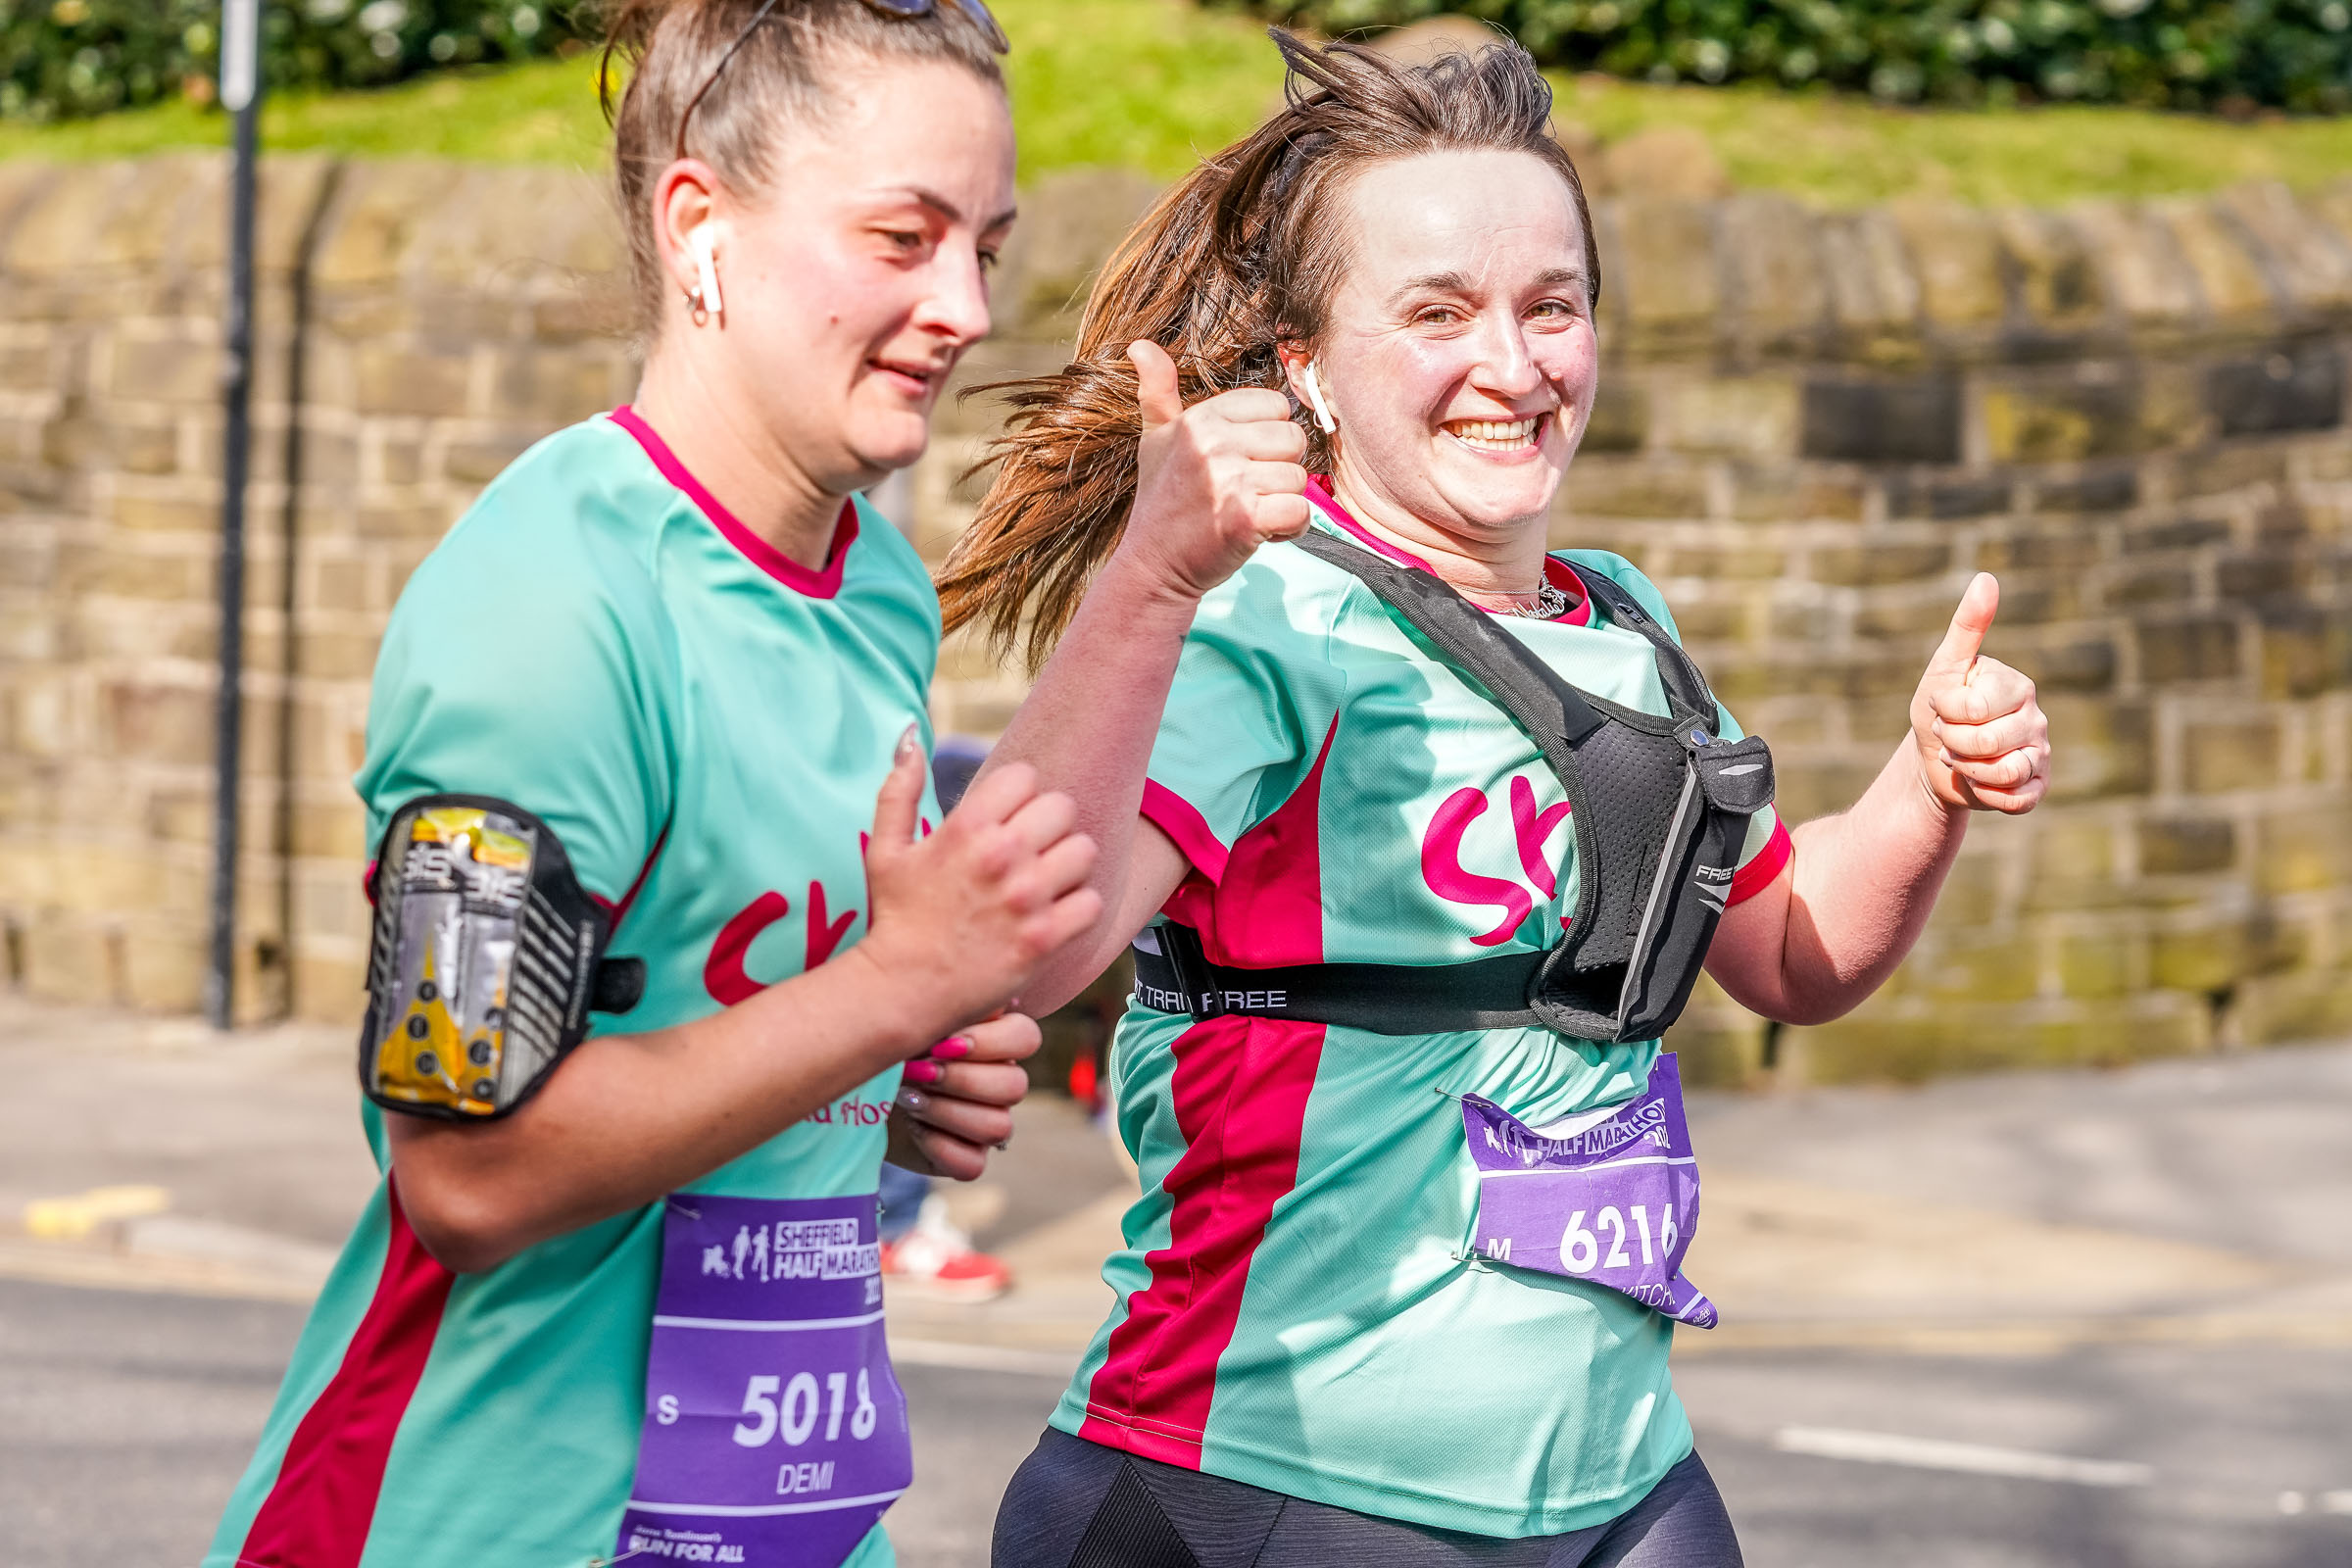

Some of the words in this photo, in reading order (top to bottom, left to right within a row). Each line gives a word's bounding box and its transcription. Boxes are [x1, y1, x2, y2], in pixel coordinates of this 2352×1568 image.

[1537, 1135, 1584, 1159] HALF
[1486, 1238, 1512, 1260] M
[1559, 1202, 1679, 1274] 6216
[773, 1251, 823, 1280] HALF
[657, 1395, 679, 1425] S
[733, 1367, 877, 1448] 5018
[776, 1461, 835, 1495] DEMI
[673, 1543, 713, 1562] FOR
[713, 1544, 745, 1563] ALL
